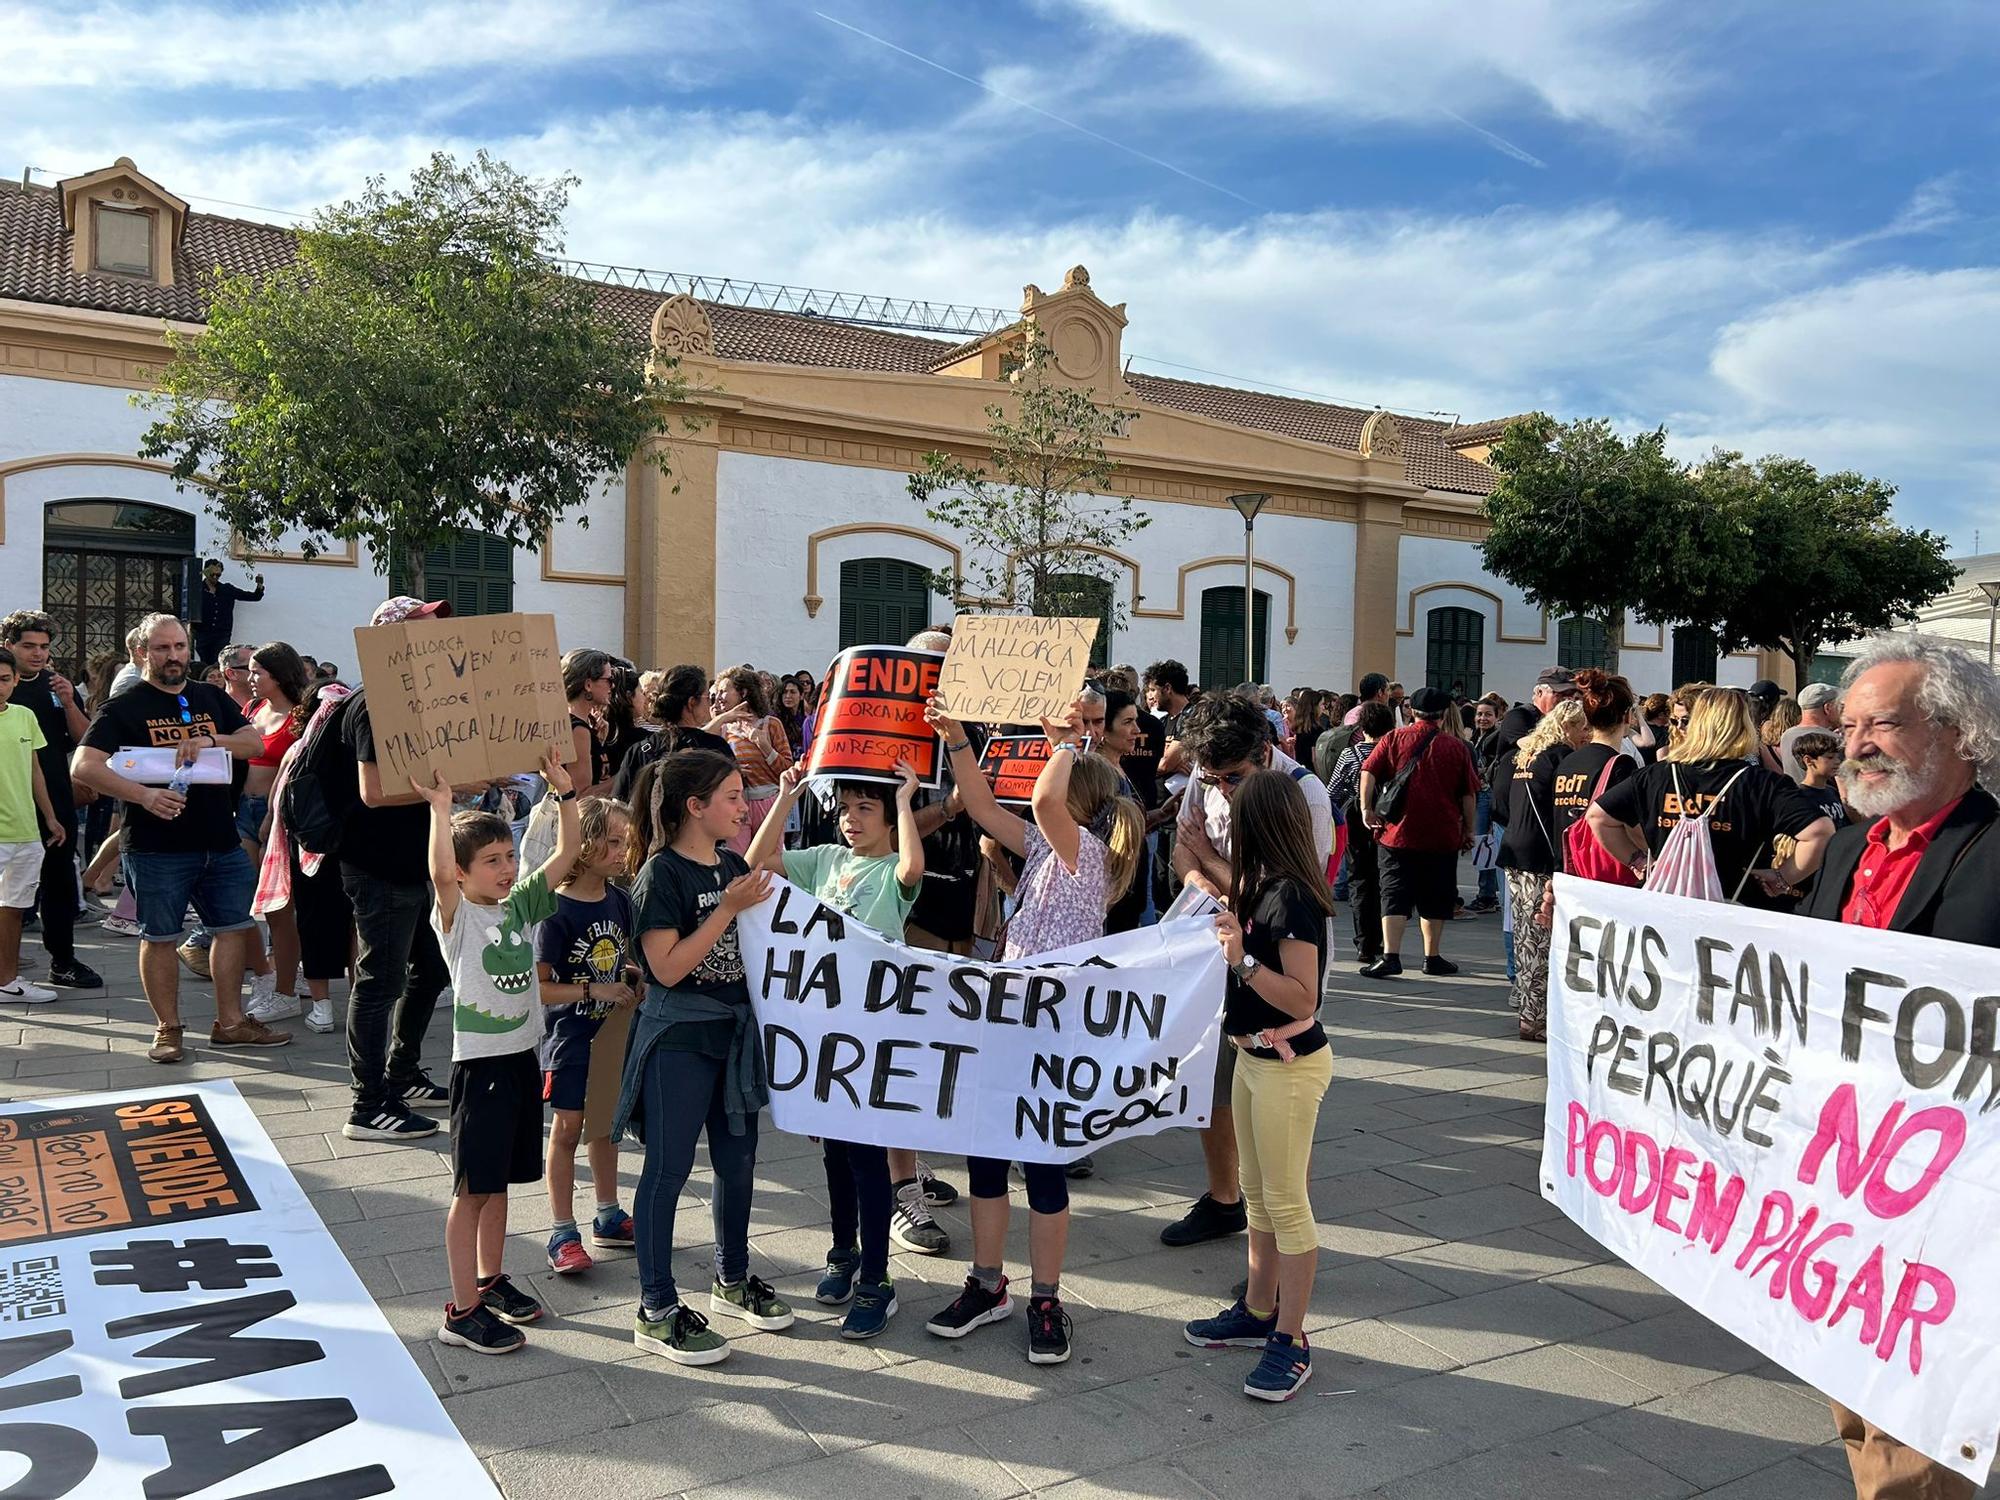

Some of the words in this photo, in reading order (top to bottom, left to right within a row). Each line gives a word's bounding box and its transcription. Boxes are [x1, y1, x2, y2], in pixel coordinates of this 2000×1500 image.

[966, 616, 1061, 639] ESTIMAM
[388, 635, 464, 668] MALLORCA
[491, 629, 523, 645] NO
[953, 635, 1073, 668] MALLORCA
[401, 663, 435, 692] ES
[448, 650, 493, 678] VEN
[982, 665, 1063, 694] VOLEM
[513, 682, 535, 696] PER
[943, 690, 1010, 717] VIURE
[895, 709, 916, 723] NO
[155, 728, 182, 742] NO
[188, 724, 211, 739] ES
[385, 717, 480, 776] MALLORCA
[850, 738, 921, 763] RESORT
[987, 740, 1014, 758] SE
[1017, 740, 1053, 758] VEN
[1012, 763, 1025, 774] NO
[1555, 774, 1588, 793] BdT
[771, 886, 846, 942] LA
[568, 937, 591, 964] SAN
[761, 947, 842, 1008] HA
[863, 959, 936, 1015] DE
[947, 966, 1067, 1033] SER
[1083, 984, 1166, 1041] UN
[1566, 916, 1667, 1014] ENS
[1695, 937, 1809, 1047] FAN
[763, 1023, 979, 1119] DRET
[1031, 1053, 1101, 1101] NO
[1113, 1056, 1178, 1097] UN
[115, 1101, 198, 1131] SE
[1015, 1084, 1188, 1148] NEGOCI
[1586, 1015, 1792, 1149] PERQUÈ
[1799, 1083, 1967, 1219] NO
[53, 1168, 104, 1193] no
[127, 1127, 240, 1216] VENDE
[55, 1196, 118, 1225] ho
[1566, 1100, 1745, 1255] PODEM
[1734, 1190, 1957, 1376] PAGAR
